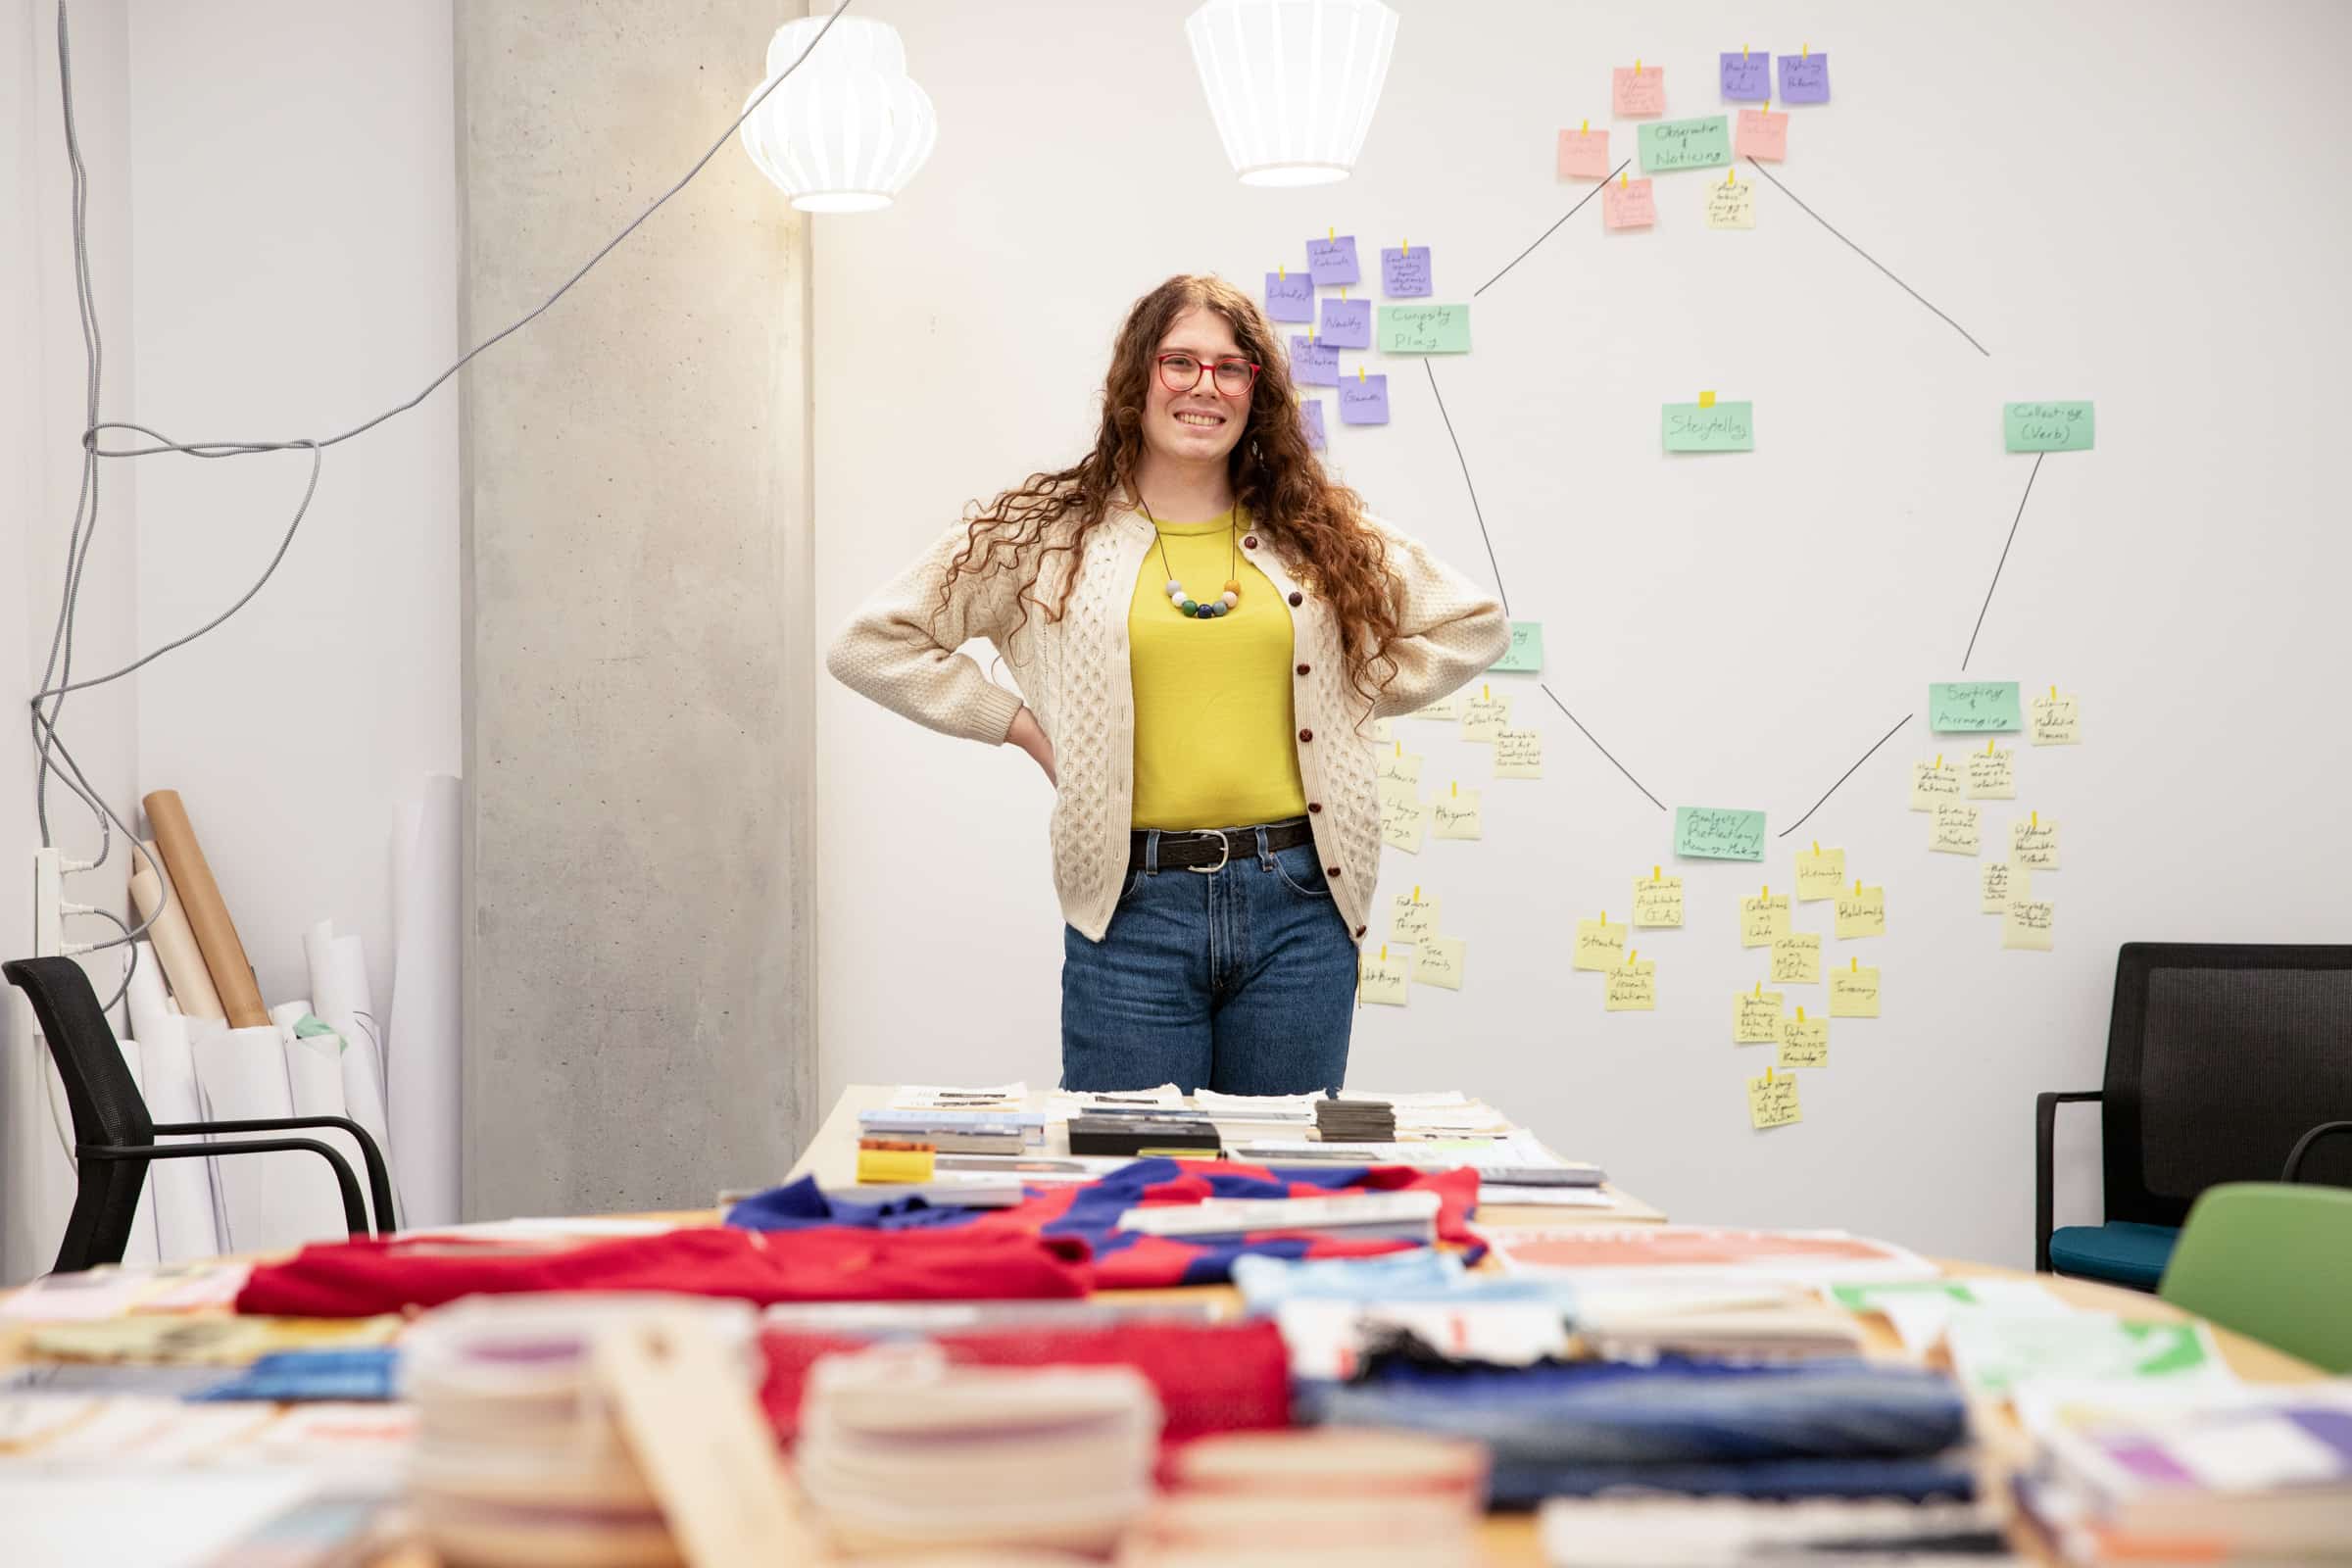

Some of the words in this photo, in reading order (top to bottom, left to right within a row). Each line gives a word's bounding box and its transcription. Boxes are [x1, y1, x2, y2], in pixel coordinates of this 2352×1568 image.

[1655, 122, 1719, 140] Observation
[1656, 150, 1721, 165] Noticing
[1396, 333, 1438, 350] Play
[1669, 415, 1748, 441] Storytelling
[2022, 422, 2071, 444] (Verb)
[1946, 684, 2004, 703] Sorting
[1938, 711, 2008, 728] Arranging
[1968, 808, 1977, 822] by
[1784, 1024, 1805, 1037] Data
